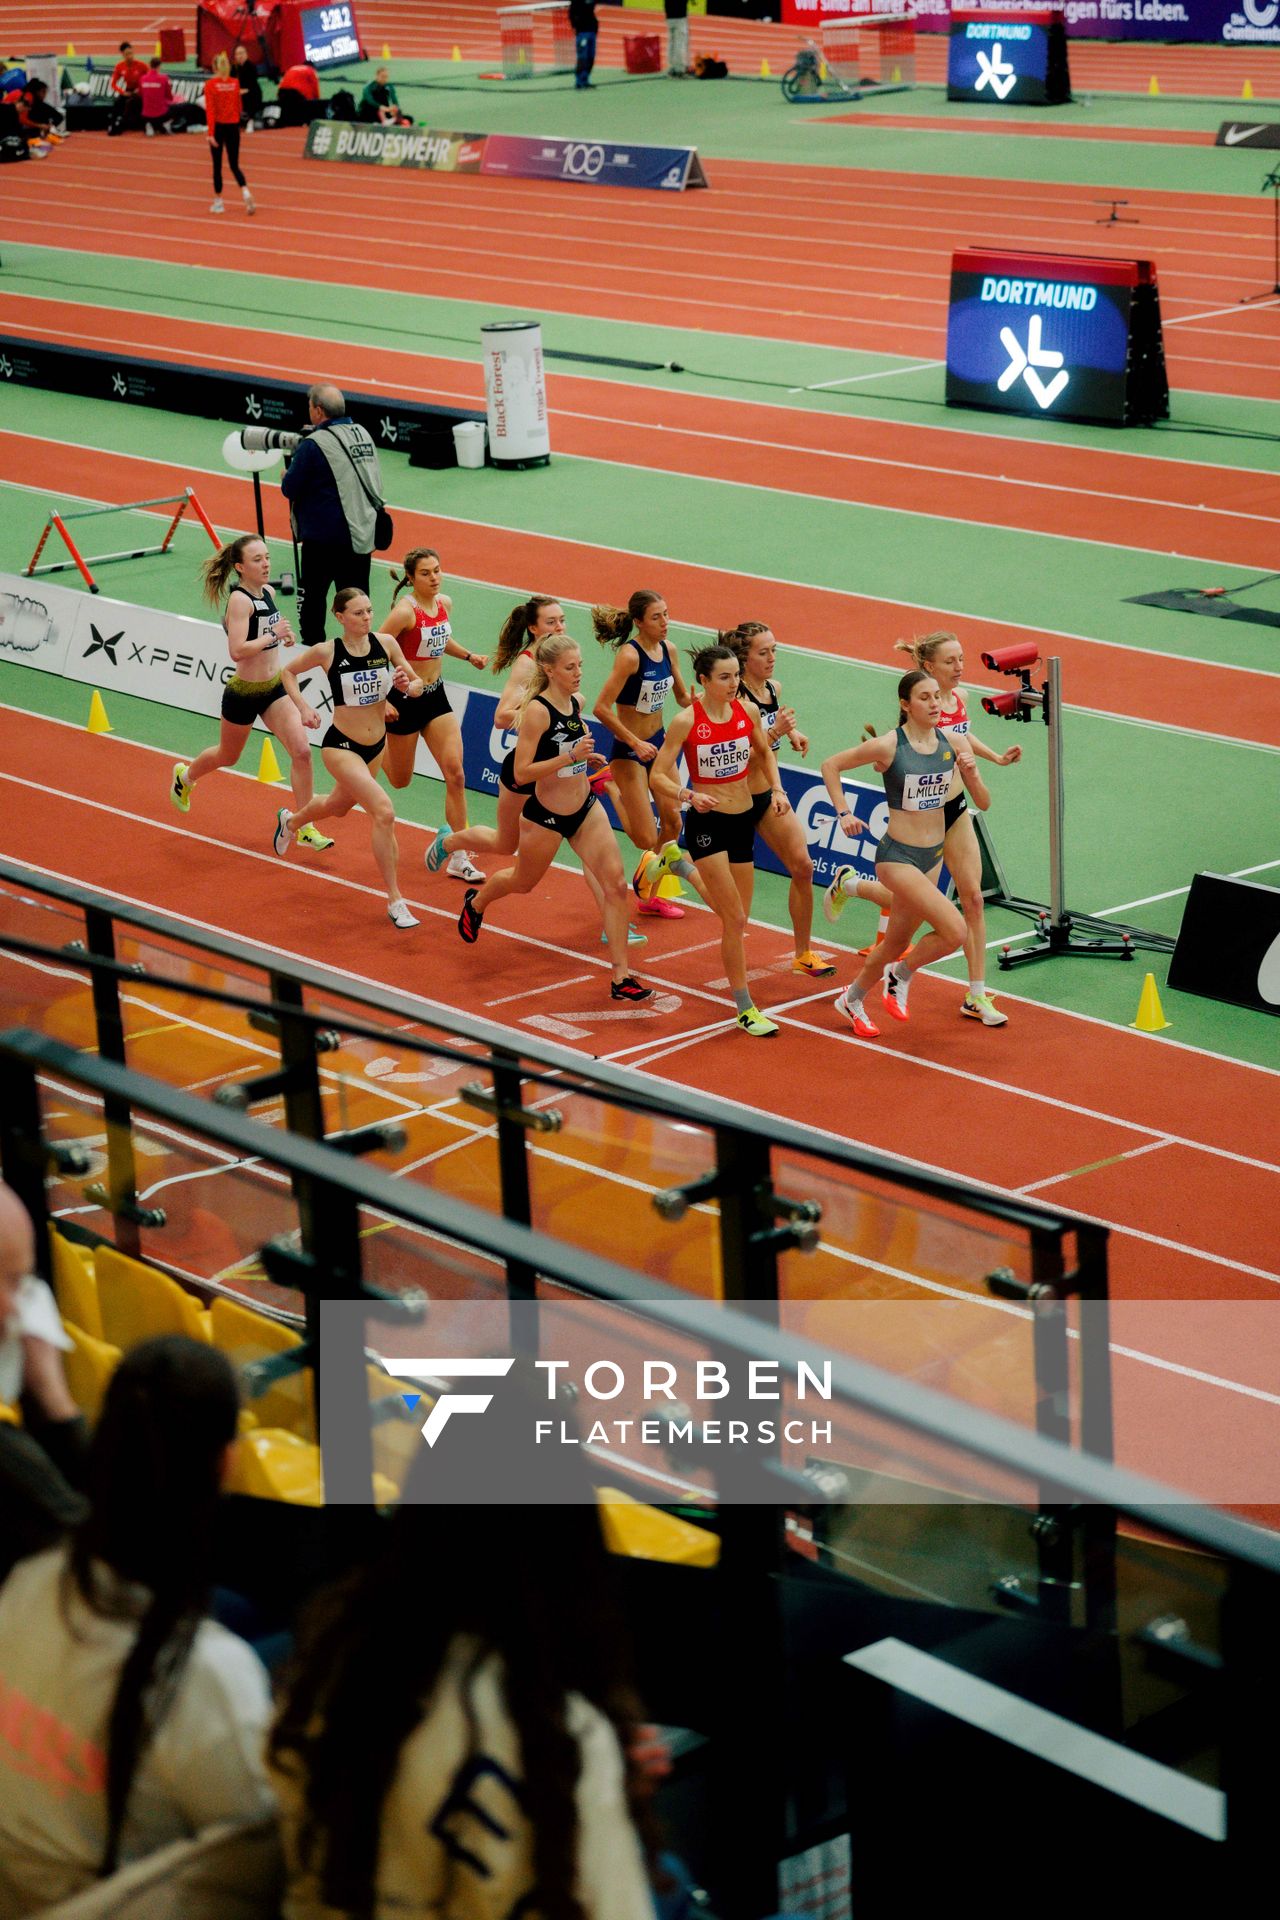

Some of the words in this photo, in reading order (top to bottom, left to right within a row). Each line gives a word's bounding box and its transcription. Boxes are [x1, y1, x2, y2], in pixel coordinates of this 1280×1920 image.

[1100, 0, 1133, 20] fürs
[1134, 1, 1190, 21] Leben.
[965, 23, 1033, 40] DORTMUND
[336, 130, 451, 163] BUNDESWEHR
[562, 143, 605, 176] 100
[981, 277, 1097, 311] DORTMUND
[491, 351, 503, 394] Forest
[495, 399, 507, 437] Black
[431, 625, 446, 637] GLS
[353, 670, 378, 683] GLS
[353, 681, 382, 695] HOFF
[653, 680, 669, 692] GLS
[710, 741, 737, 755] GLS
[700, 749, 749, 768] MEYBERG
[918, 774, 944, 786] GLS
